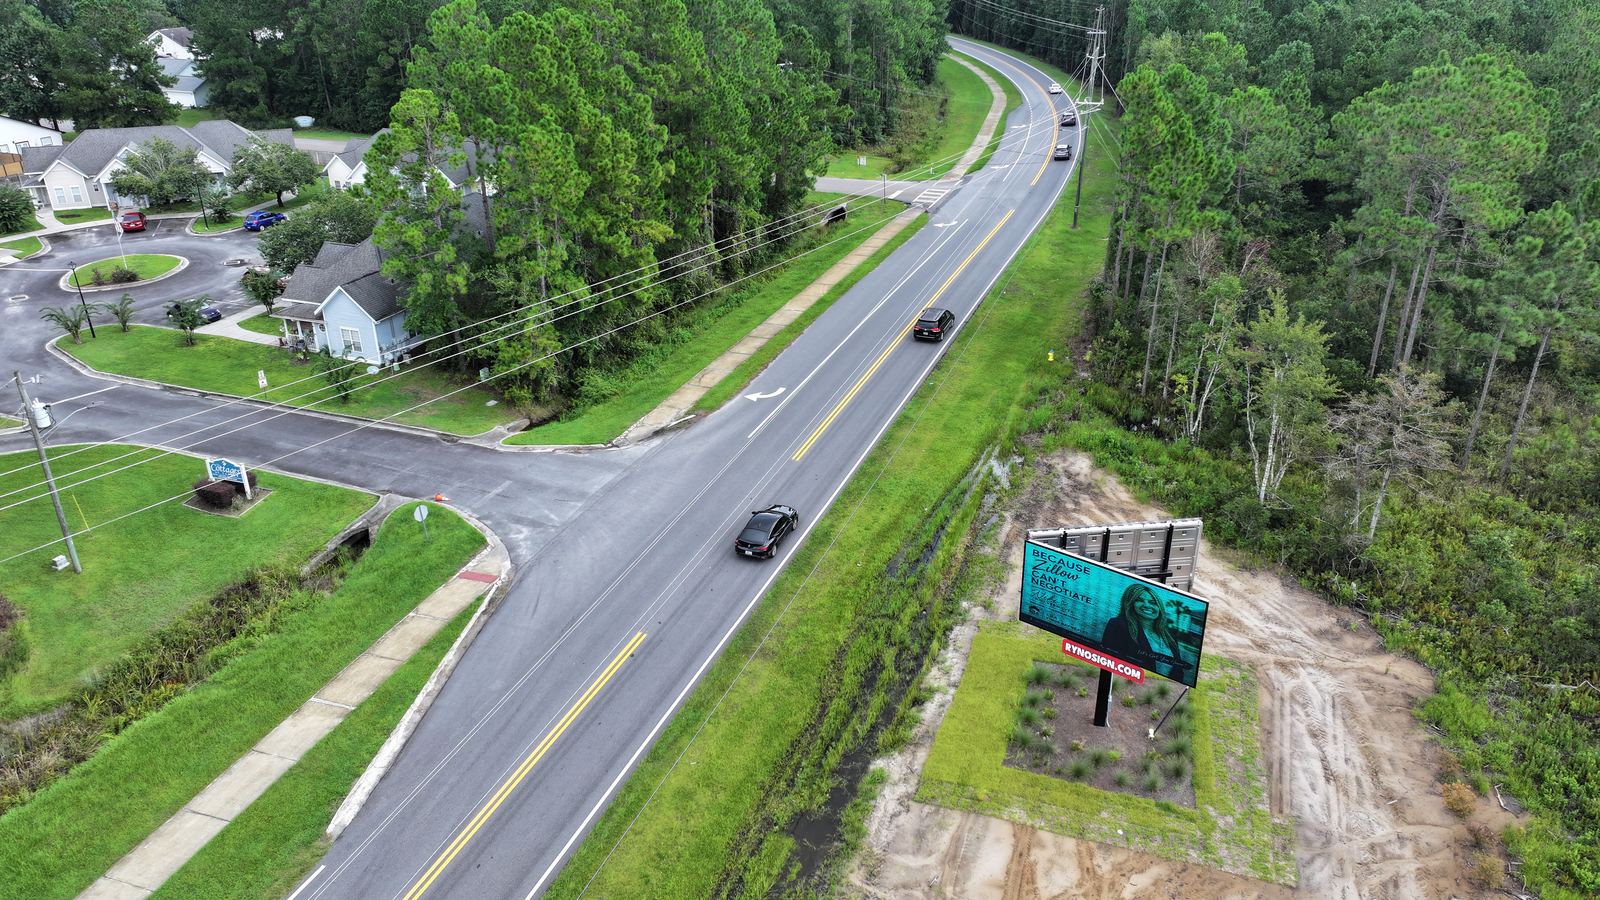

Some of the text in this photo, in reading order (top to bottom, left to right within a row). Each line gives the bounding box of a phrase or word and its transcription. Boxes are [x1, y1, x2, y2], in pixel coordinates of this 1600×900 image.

[1032, 549, 1091, 575] BECAUSE
[1032, 559, 1080, 581] Zillow
[1031, 570, 1067, 587] CAN'T
[1065, 642, 1141, 680] RYNOSIGN.COM
